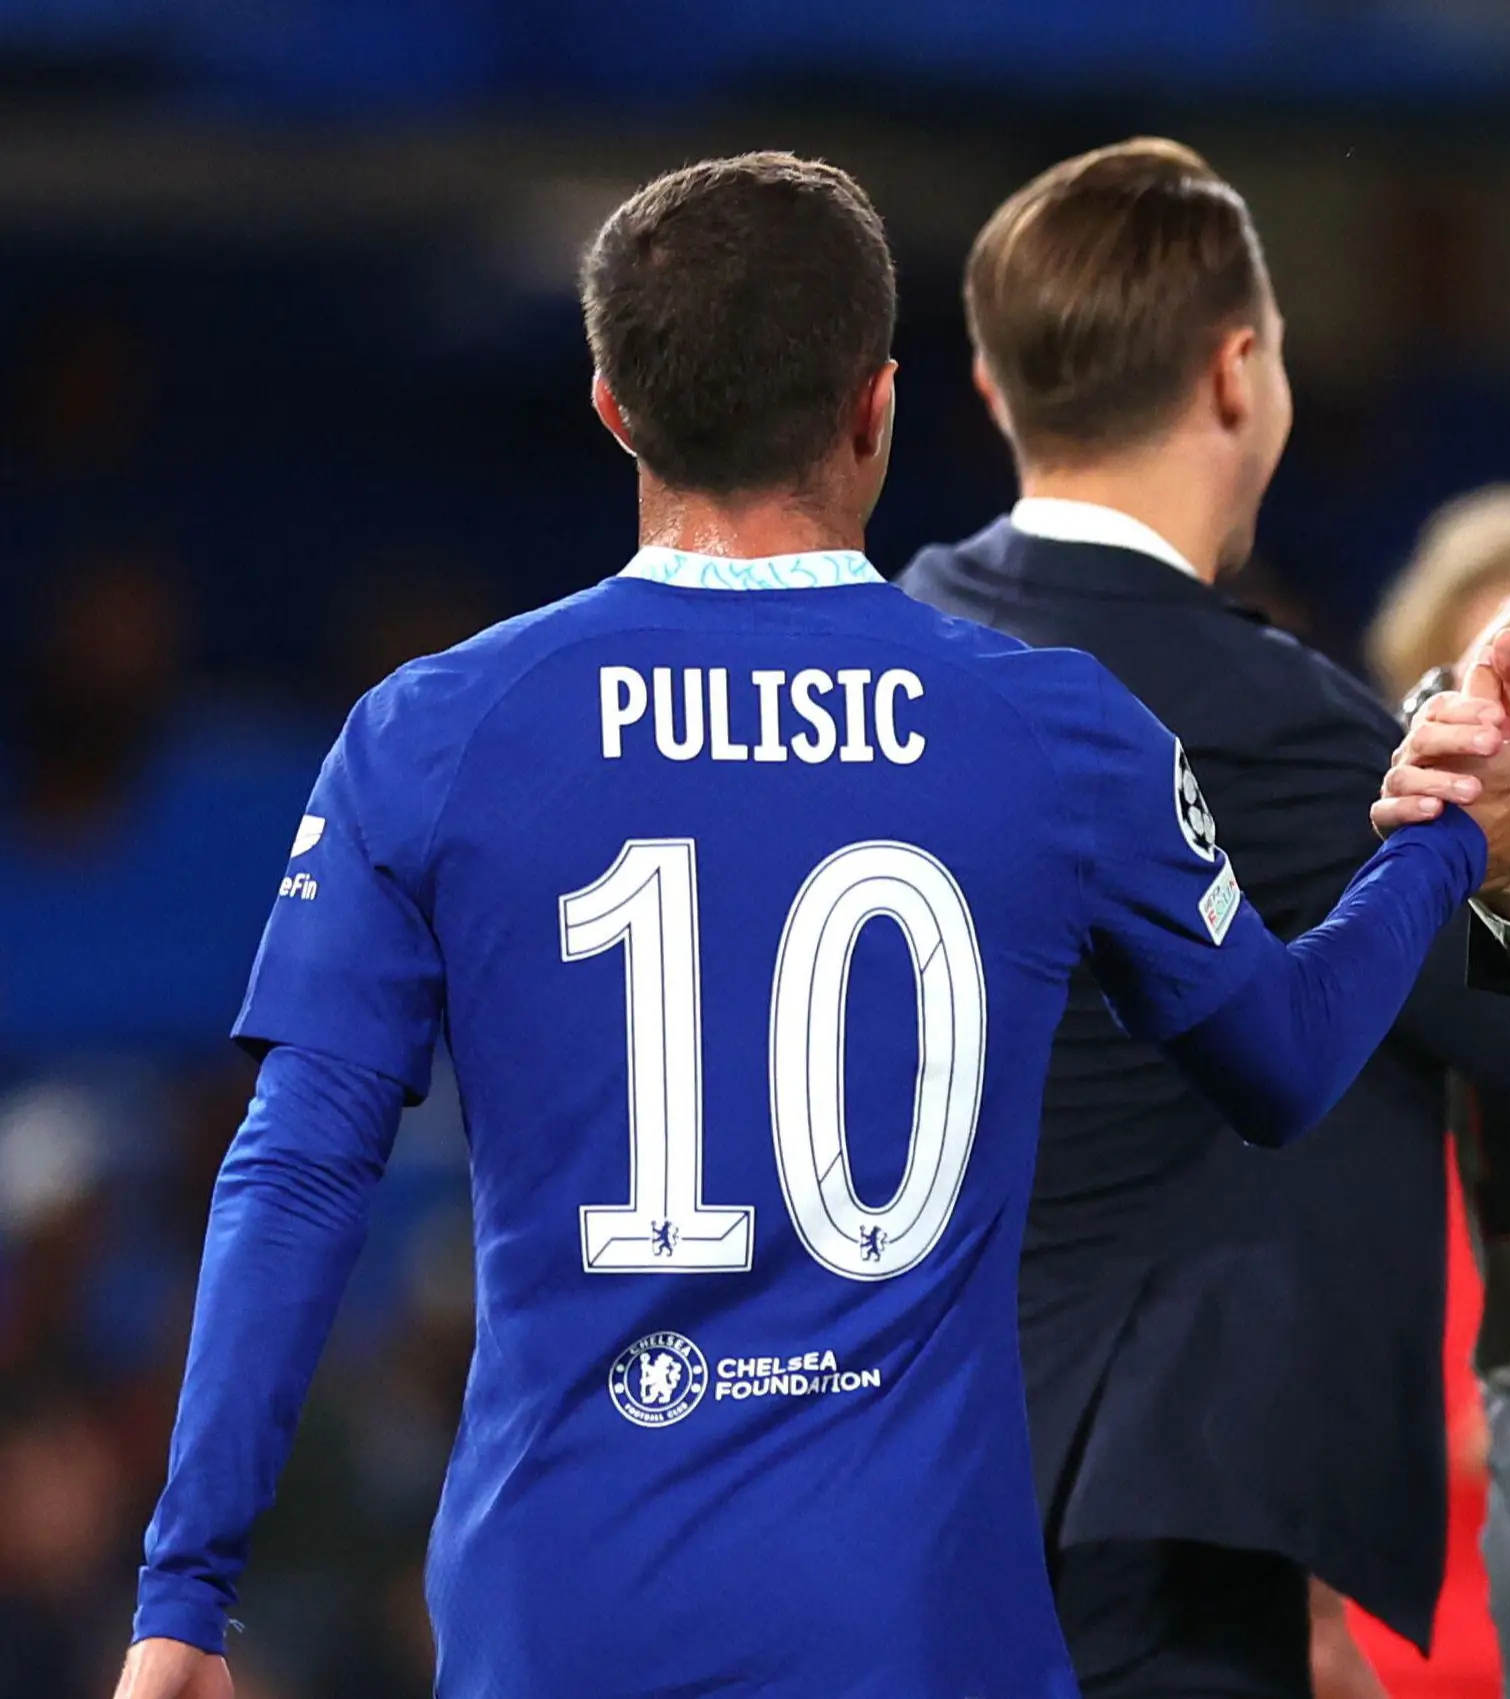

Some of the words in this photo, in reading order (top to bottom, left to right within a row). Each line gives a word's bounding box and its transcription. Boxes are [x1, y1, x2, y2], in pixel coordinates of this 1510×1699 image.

[599, 665, 925, 765] PULISIC
[279, 872, 318, 901] eFin
[558, 837, 988, 1282] 10
[628, 1335, 692, 1357] CHELSEA
[716, 1350, 837, 1379] CHELSEA
[714, 1368, 882, 1401] FOUNDATION
[624, 1402, 665, 1422] FOOTBALL
[666, 1401, 689, 1419] CLUB
